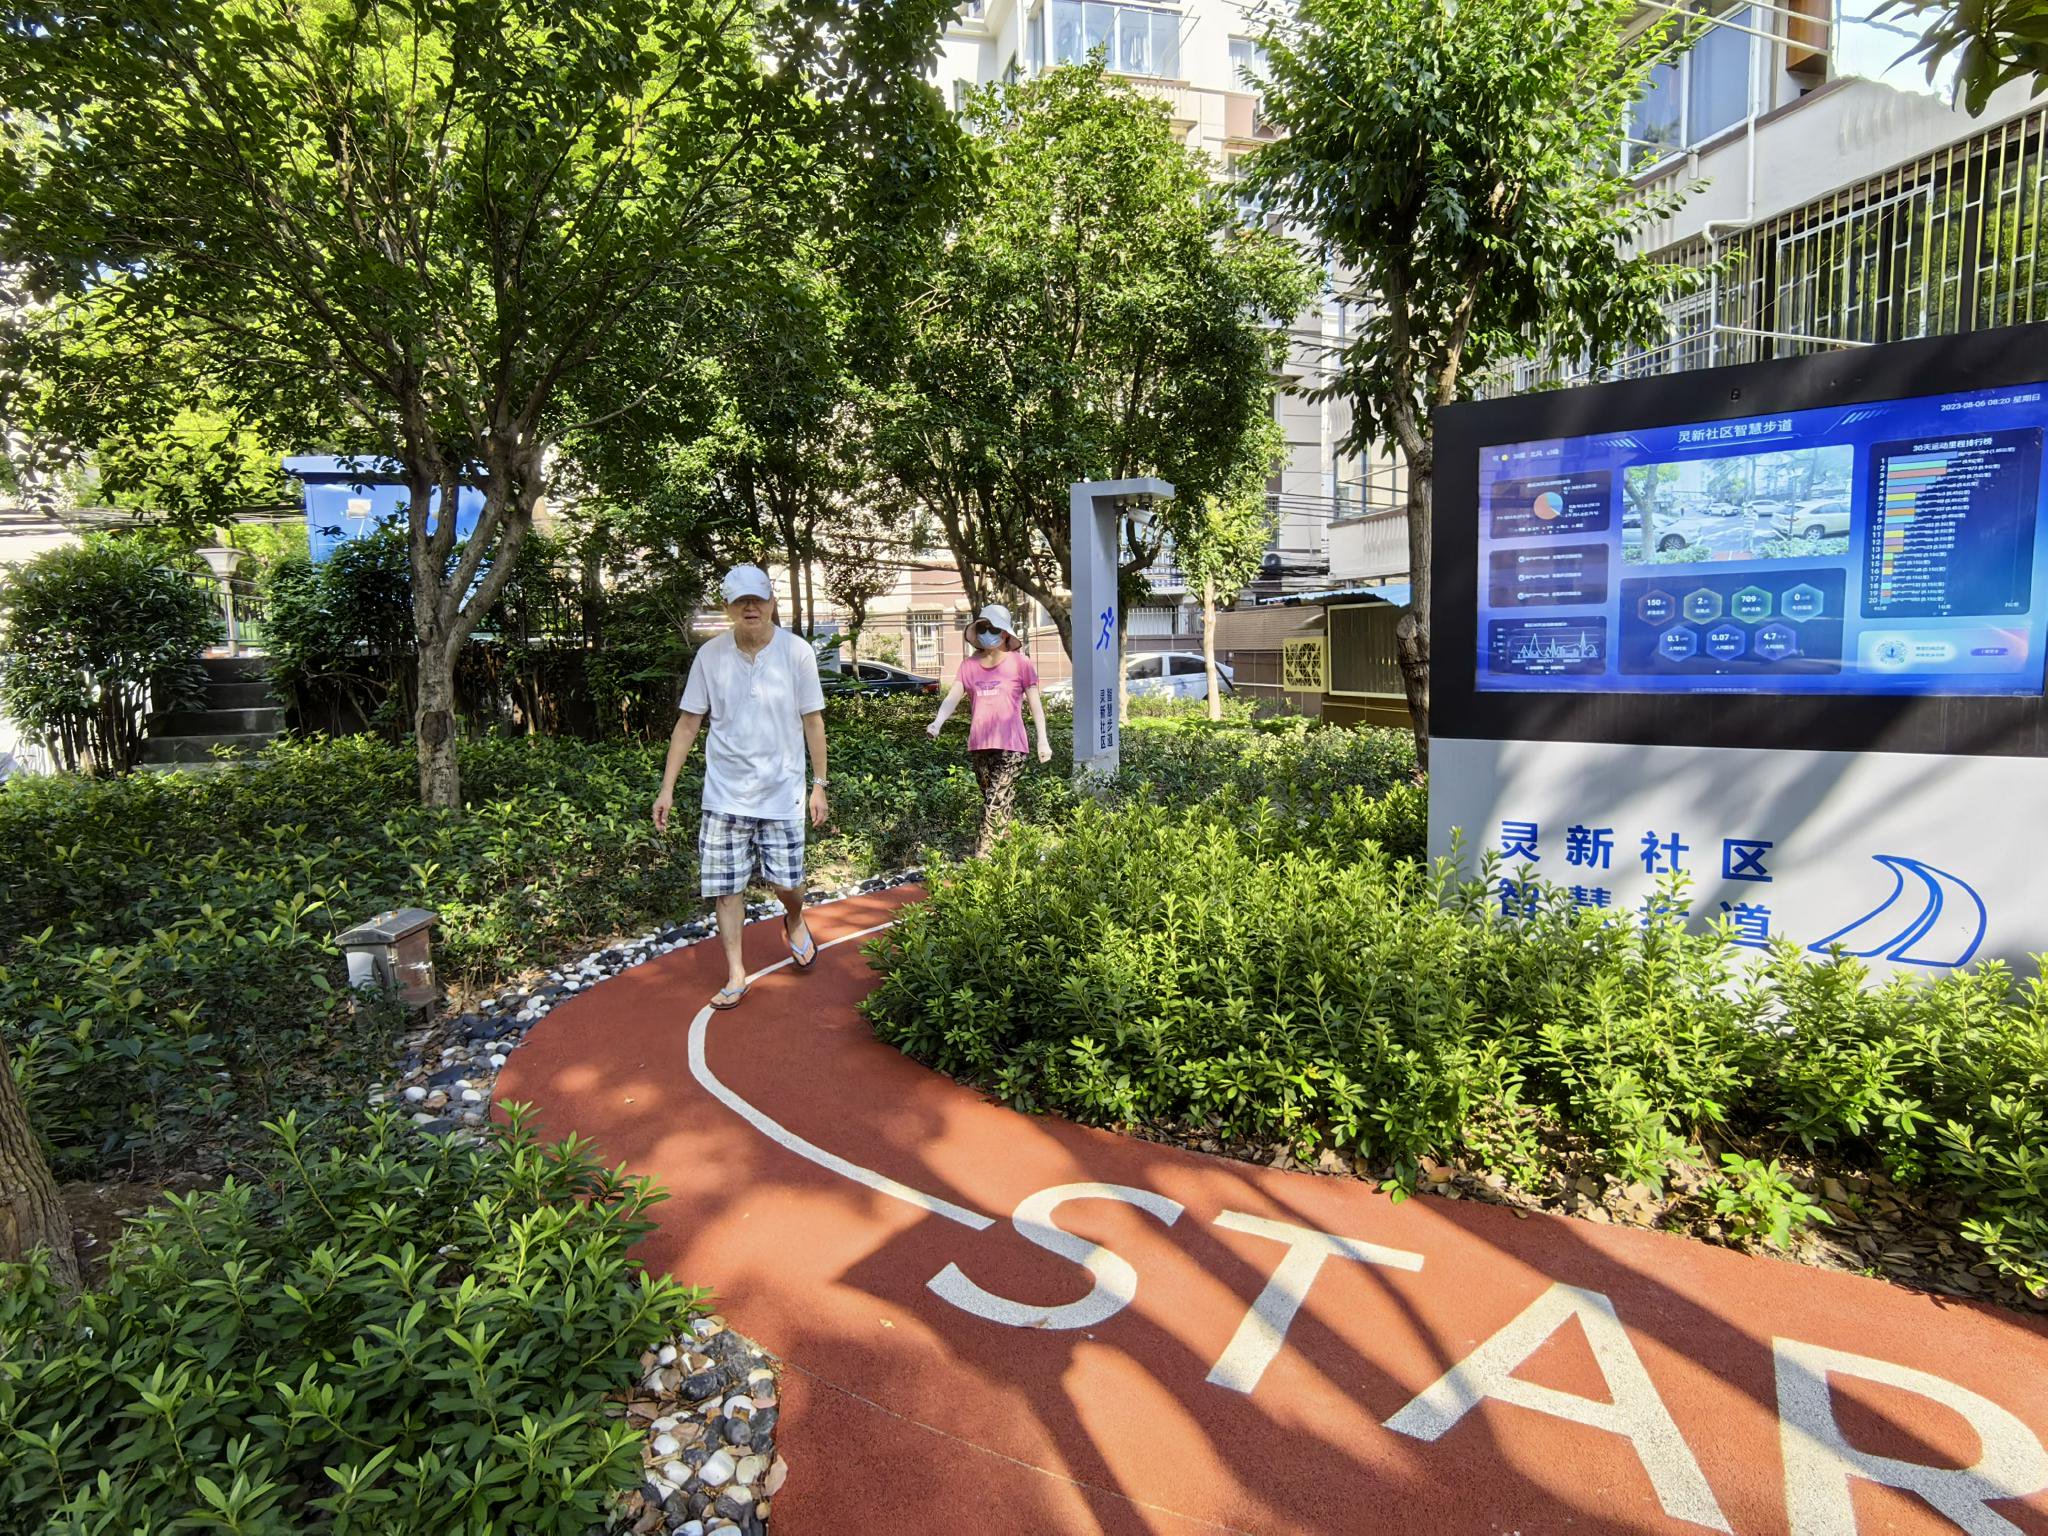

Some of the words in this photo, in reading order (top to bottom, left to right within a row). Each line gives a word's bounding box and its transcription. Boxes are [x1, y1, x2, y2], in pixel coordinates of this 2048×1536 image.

[1678, 418, 1793, 444] 灵新社区智慧步道
[1711, 633, 1730, 641] 0.07
[1763, 632, 1776, 640] 4.7
[1500, 820, 1774, 883] 灵新社区
[925, 1181, 2048, 1536] STAR
